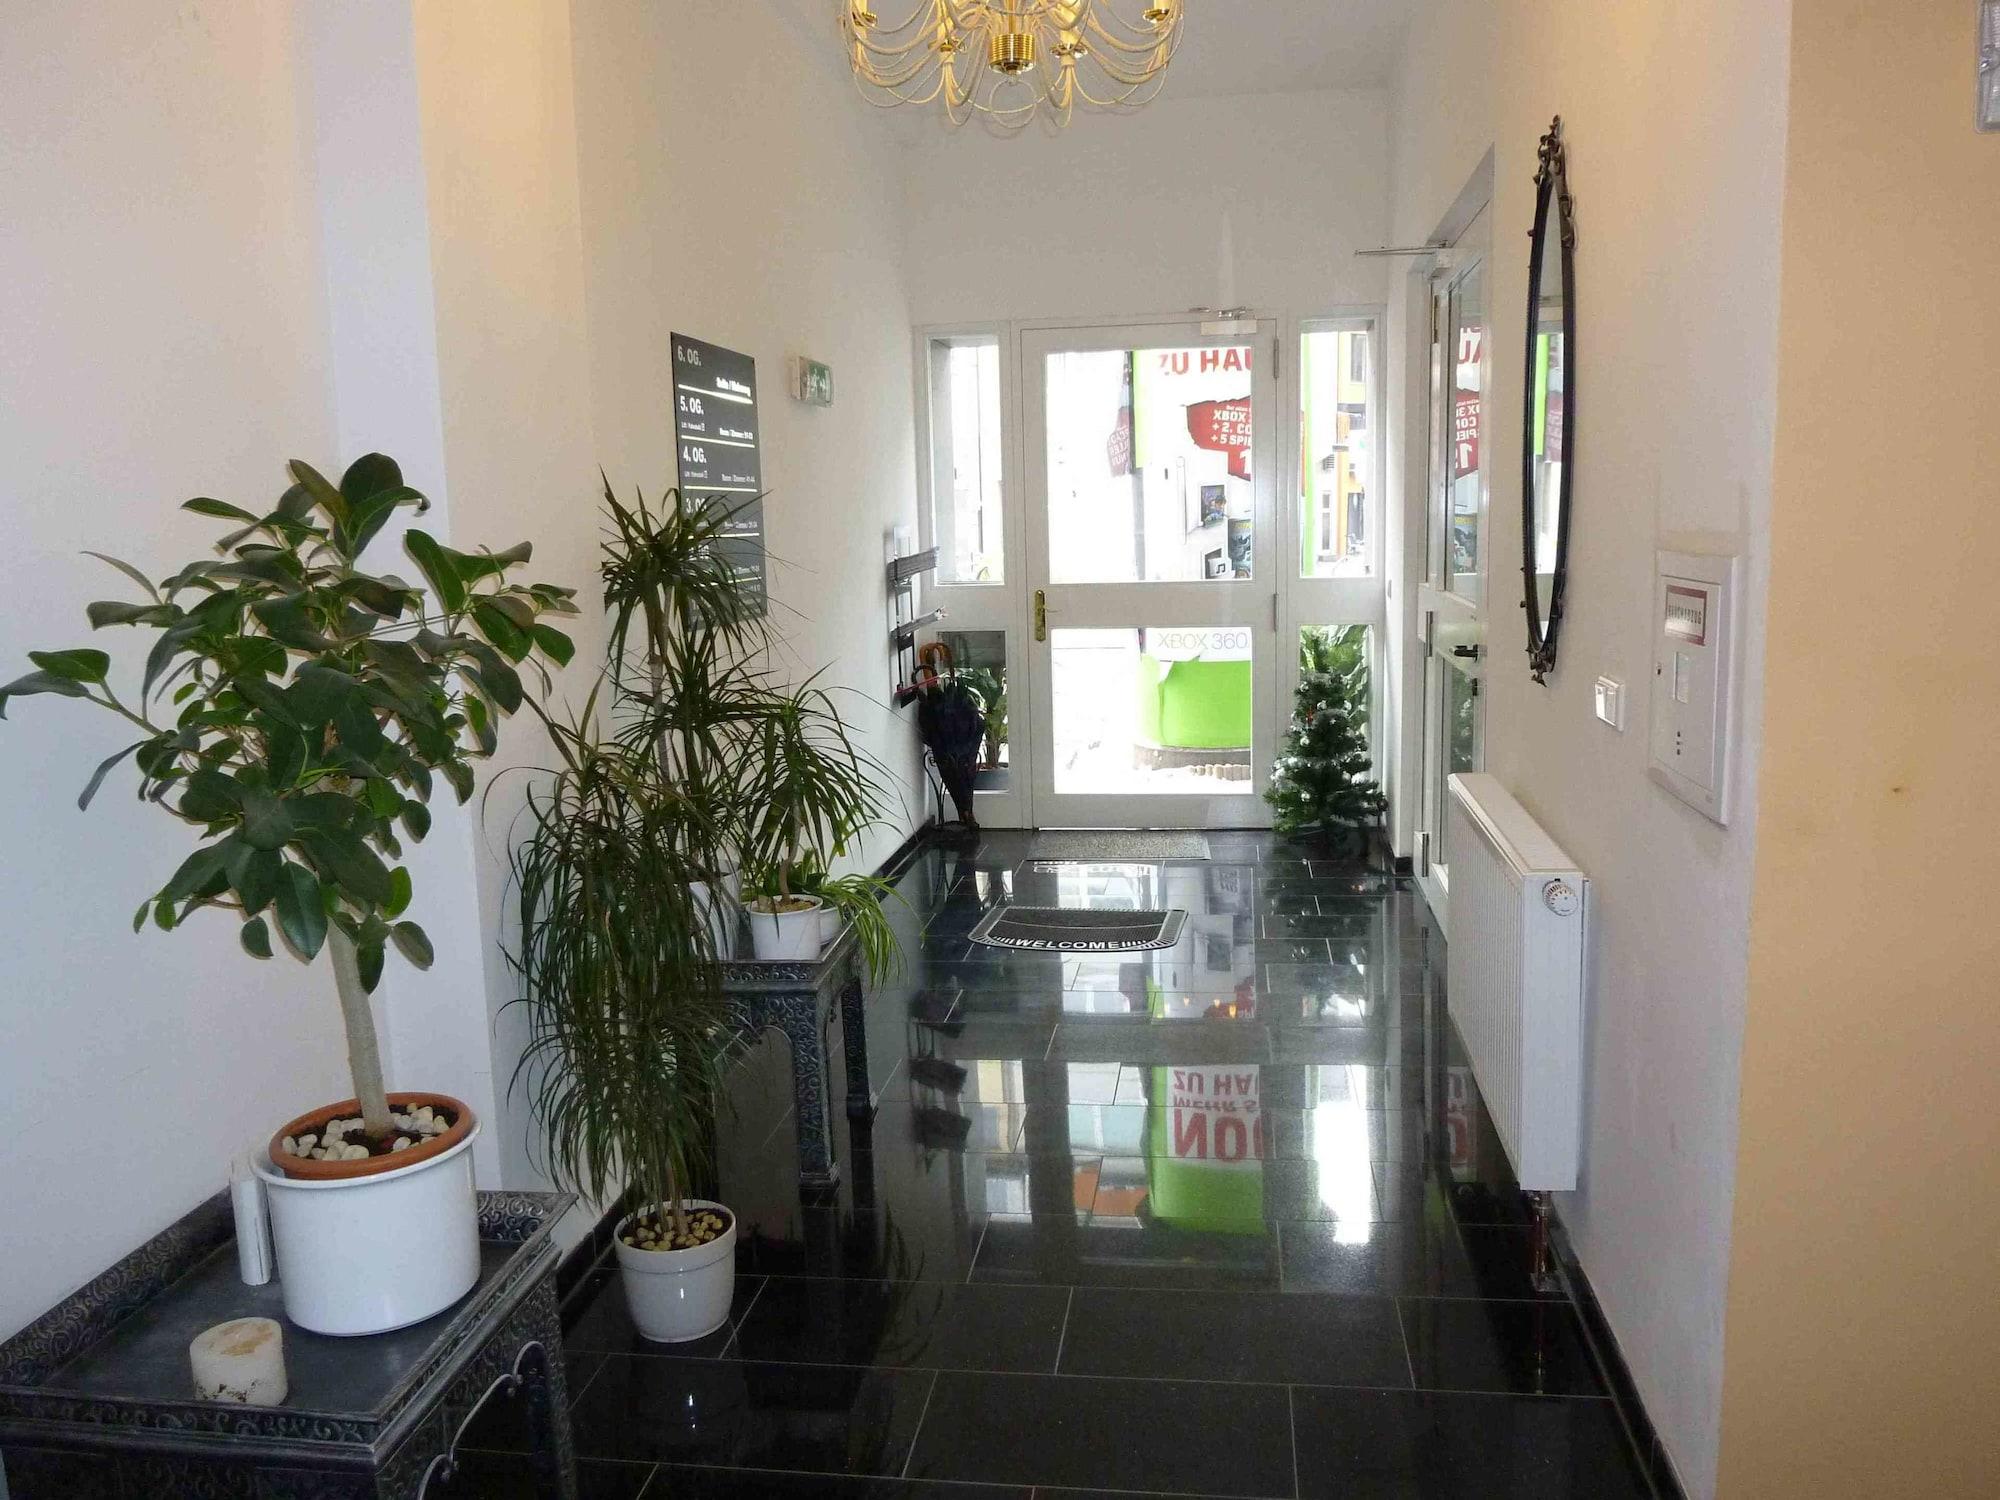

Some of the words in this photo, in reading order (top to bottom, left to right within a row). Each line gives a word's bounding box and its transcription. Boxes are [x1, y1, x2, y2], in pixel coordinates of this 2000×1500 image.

[678, 345, 686, 361] 6.
[687, 348, 702, 366] OG.
[680, 396, 689, 412] 5.
[689, 398, 705, 415] OG.
[1213, 410, 1246, 423] XBOX
[1219, 433, 1228, 444] 5
[683, 445, 692, 462] 4.
[692, 447, 707, 463] OG.
[686, 498, 694, 514] 3.
[1157, 633, 1209, 650] XBOX
[1211, 632, 1249, 650] 360
[1014, 937, 1121, 950] WELCOME
